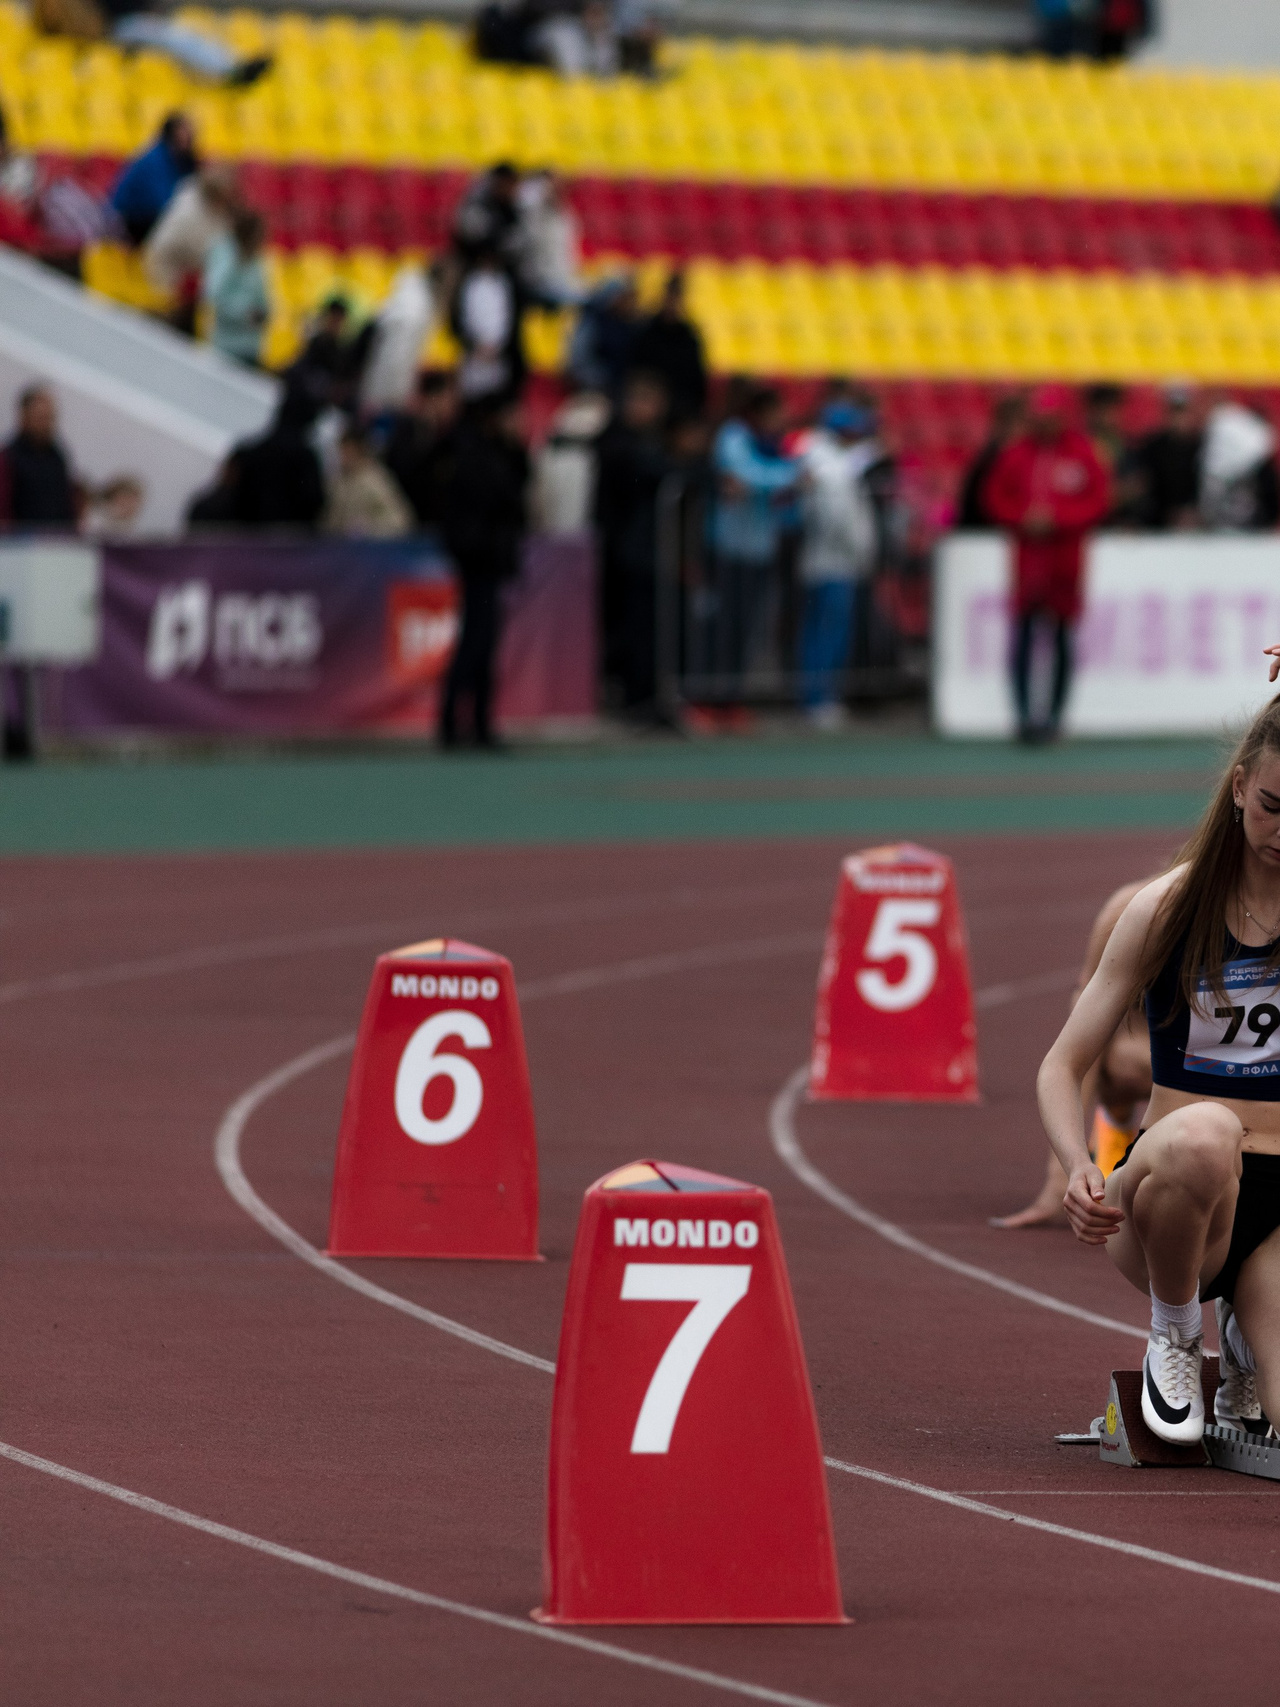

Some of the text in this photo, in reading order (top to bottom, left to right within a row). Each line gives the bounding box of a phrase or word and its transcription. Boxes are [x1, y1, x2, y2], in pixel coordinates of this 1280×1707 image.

[391, 974, 500, 1000] MONDO
[855, 899, 941, 1013] 5
[395, 1009, 492, 1146] 6
[1242, 1064, 1279, 1075] ВФЛА
[613, 1218, 759, 1248] MONDO
[620, 1263, 752, 1454] 7
